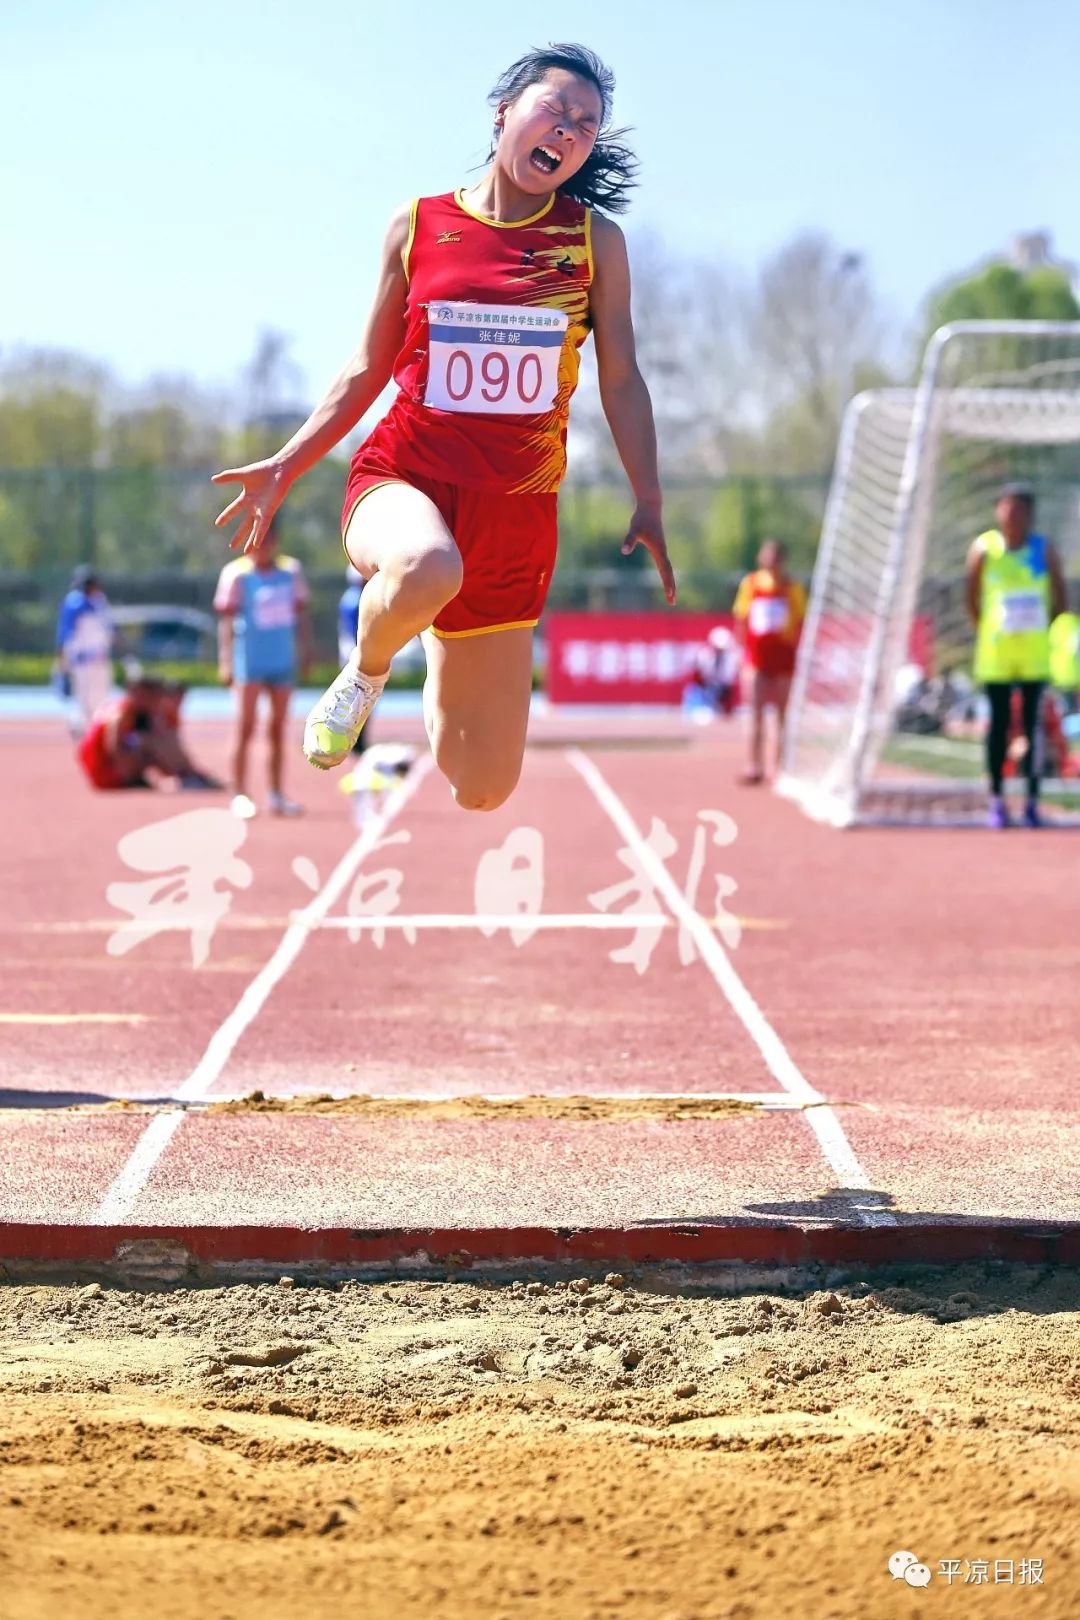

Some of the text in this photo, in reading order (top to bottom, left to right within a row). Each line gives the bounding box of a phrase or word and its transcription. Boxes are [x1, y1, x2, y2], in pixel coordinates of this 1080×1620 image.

[457, 312, 560, 327] 平凉市第四届中学生运动会
[479, 330, 521, 344] 张佳妮
[446, 350, 542, 403] 090
